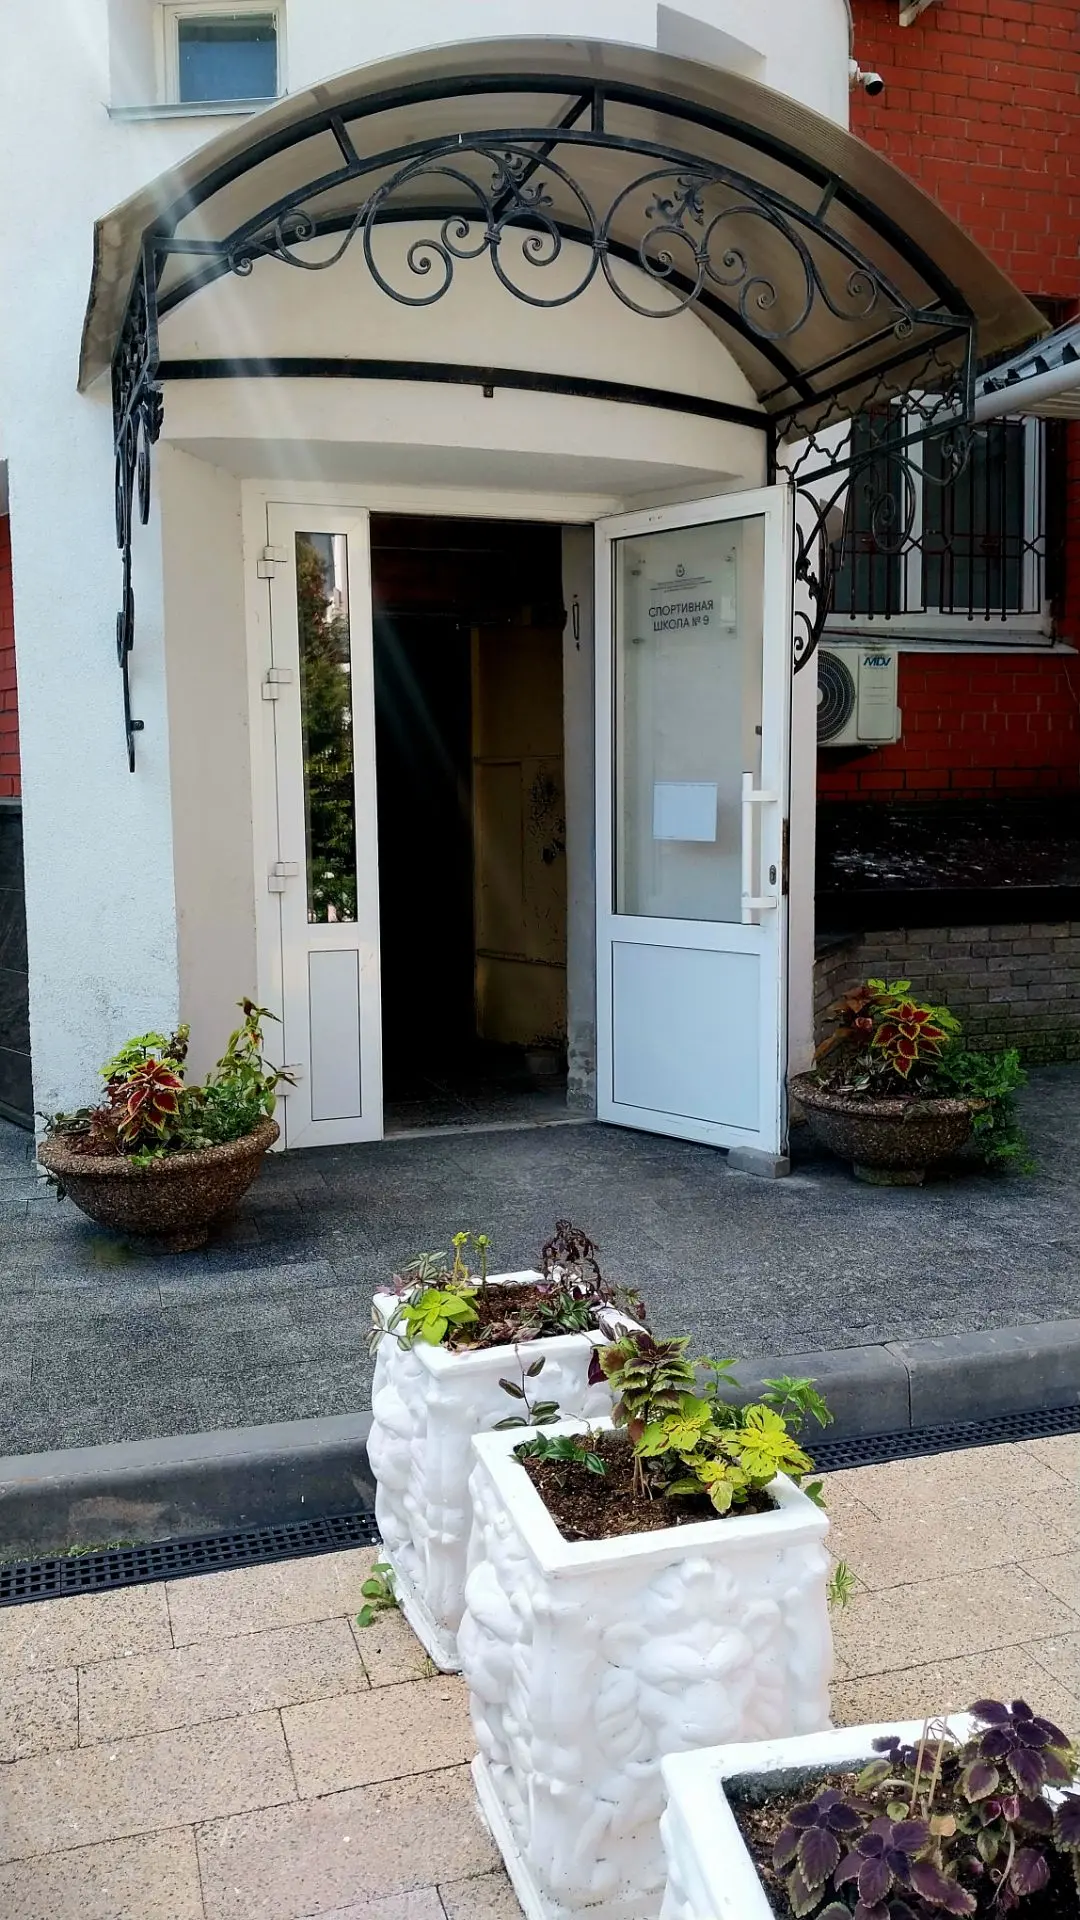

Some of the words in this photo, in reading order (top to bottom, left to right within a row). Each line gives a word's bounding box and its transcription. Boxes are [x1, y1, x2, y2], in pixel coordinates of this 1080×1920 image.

[648, 600, 714, 617] СПОРТИВНАЯ
[653, 618, 690, 632] ШКОЛА
[692, 615, 701, 626] №
[702, 615, 710, 625] 9
[863, 656, 892, 667] MDV
